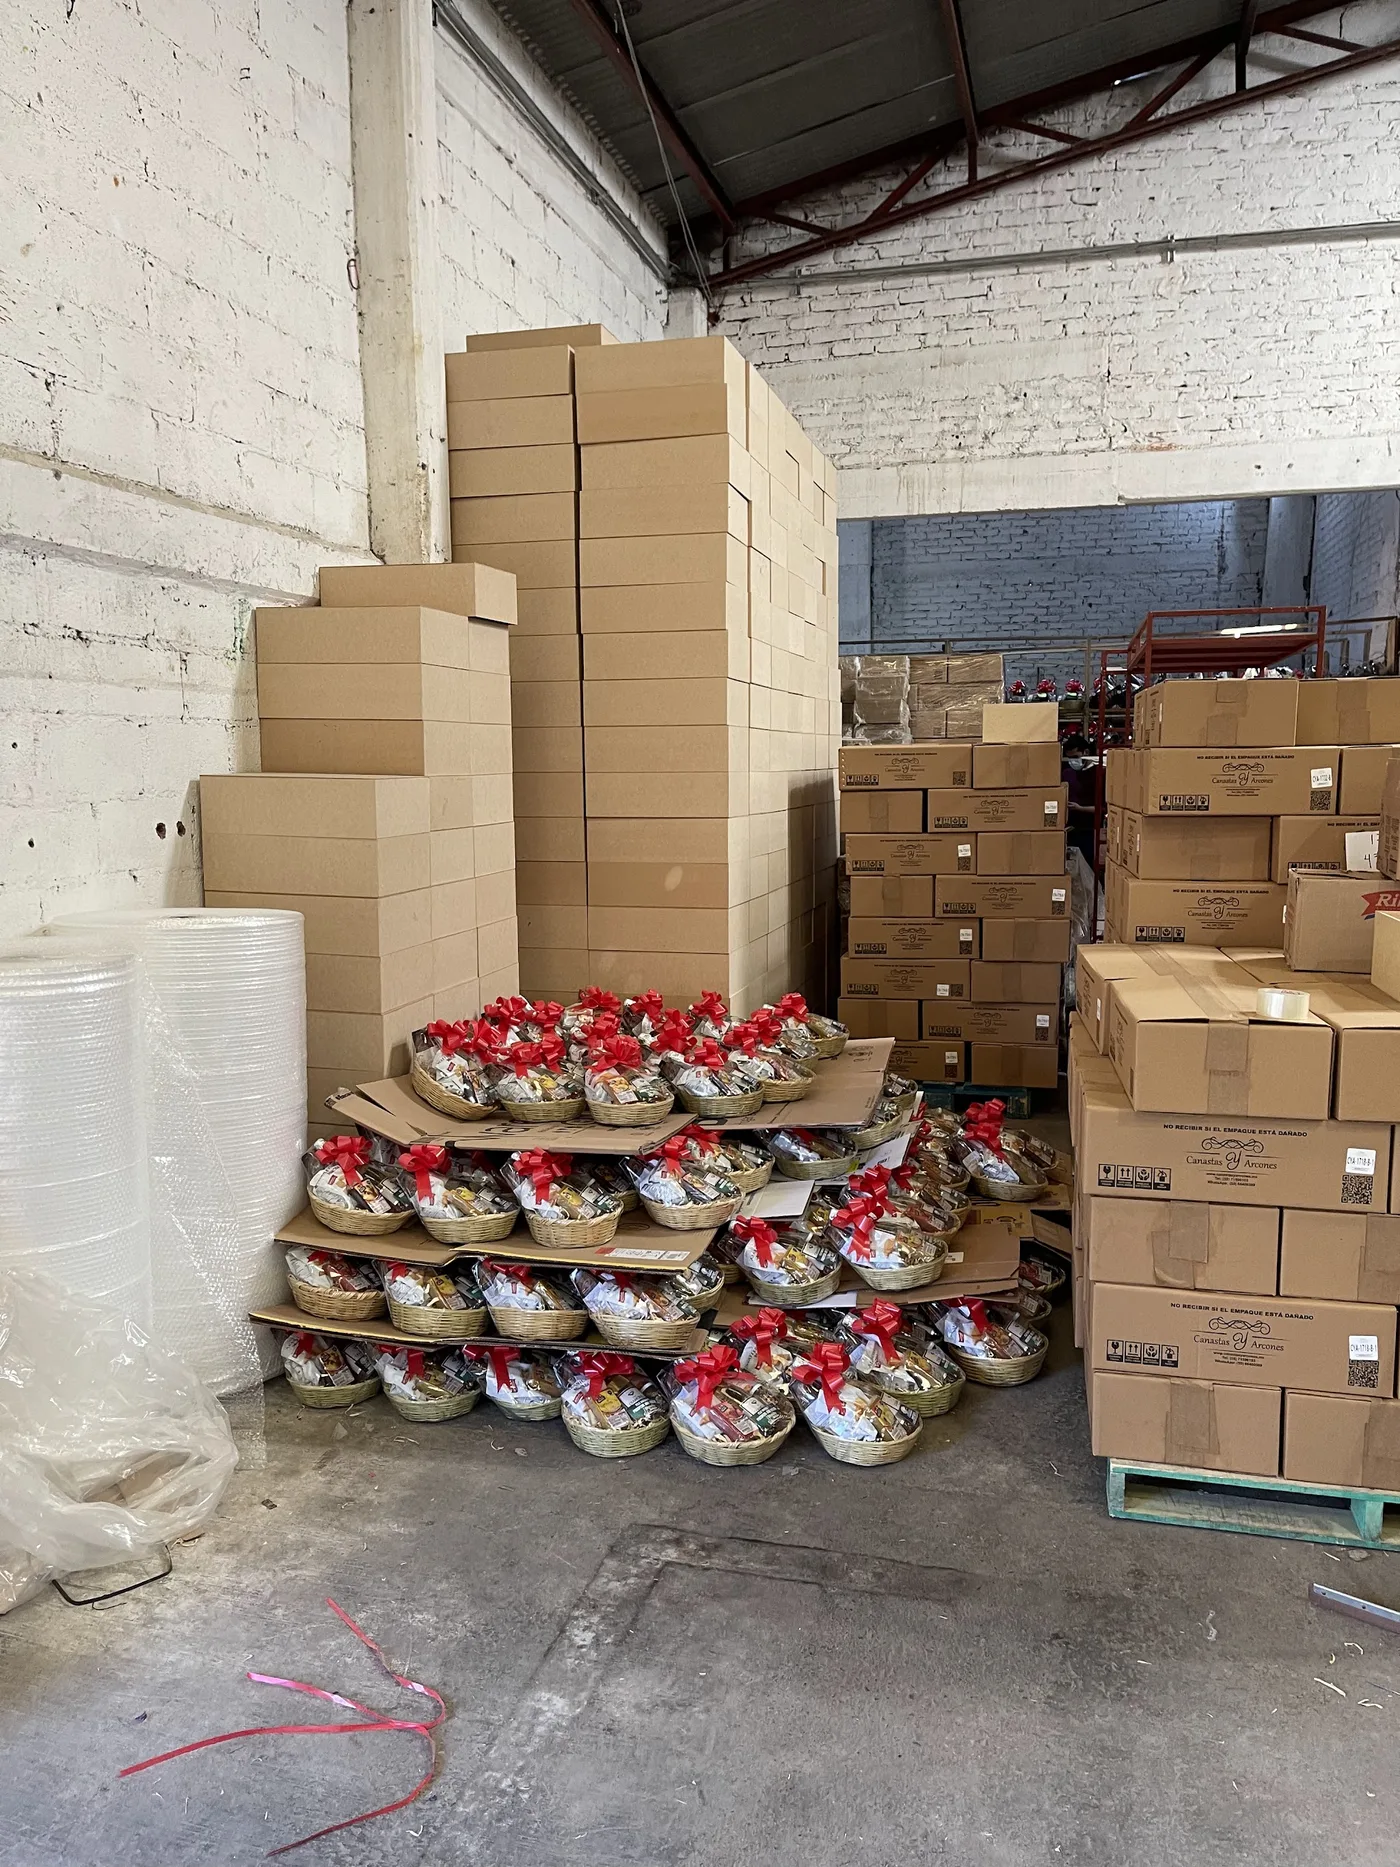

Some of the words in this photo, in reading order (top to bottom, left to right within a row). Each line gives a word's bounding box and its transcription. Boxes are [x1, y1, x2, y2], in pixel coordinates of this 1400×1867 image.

[1376, 893, 1400, 908] Ri
[1186, 1155, 1222, 1166] Canastas
[1226, 1150, 1242, 1170] Y
[1244, 1158, 1278, 1170] Arcones
[1265, 1310, 1283, 1318] ESTÁ
[1285, 1312, 1314, 1320] DAÑADO
[1194, 1334, 1230, 1346] Canastas
[1232, 1330, 1249, 1351] Y
[1251, 1340, 1284, 1352] Arcones
